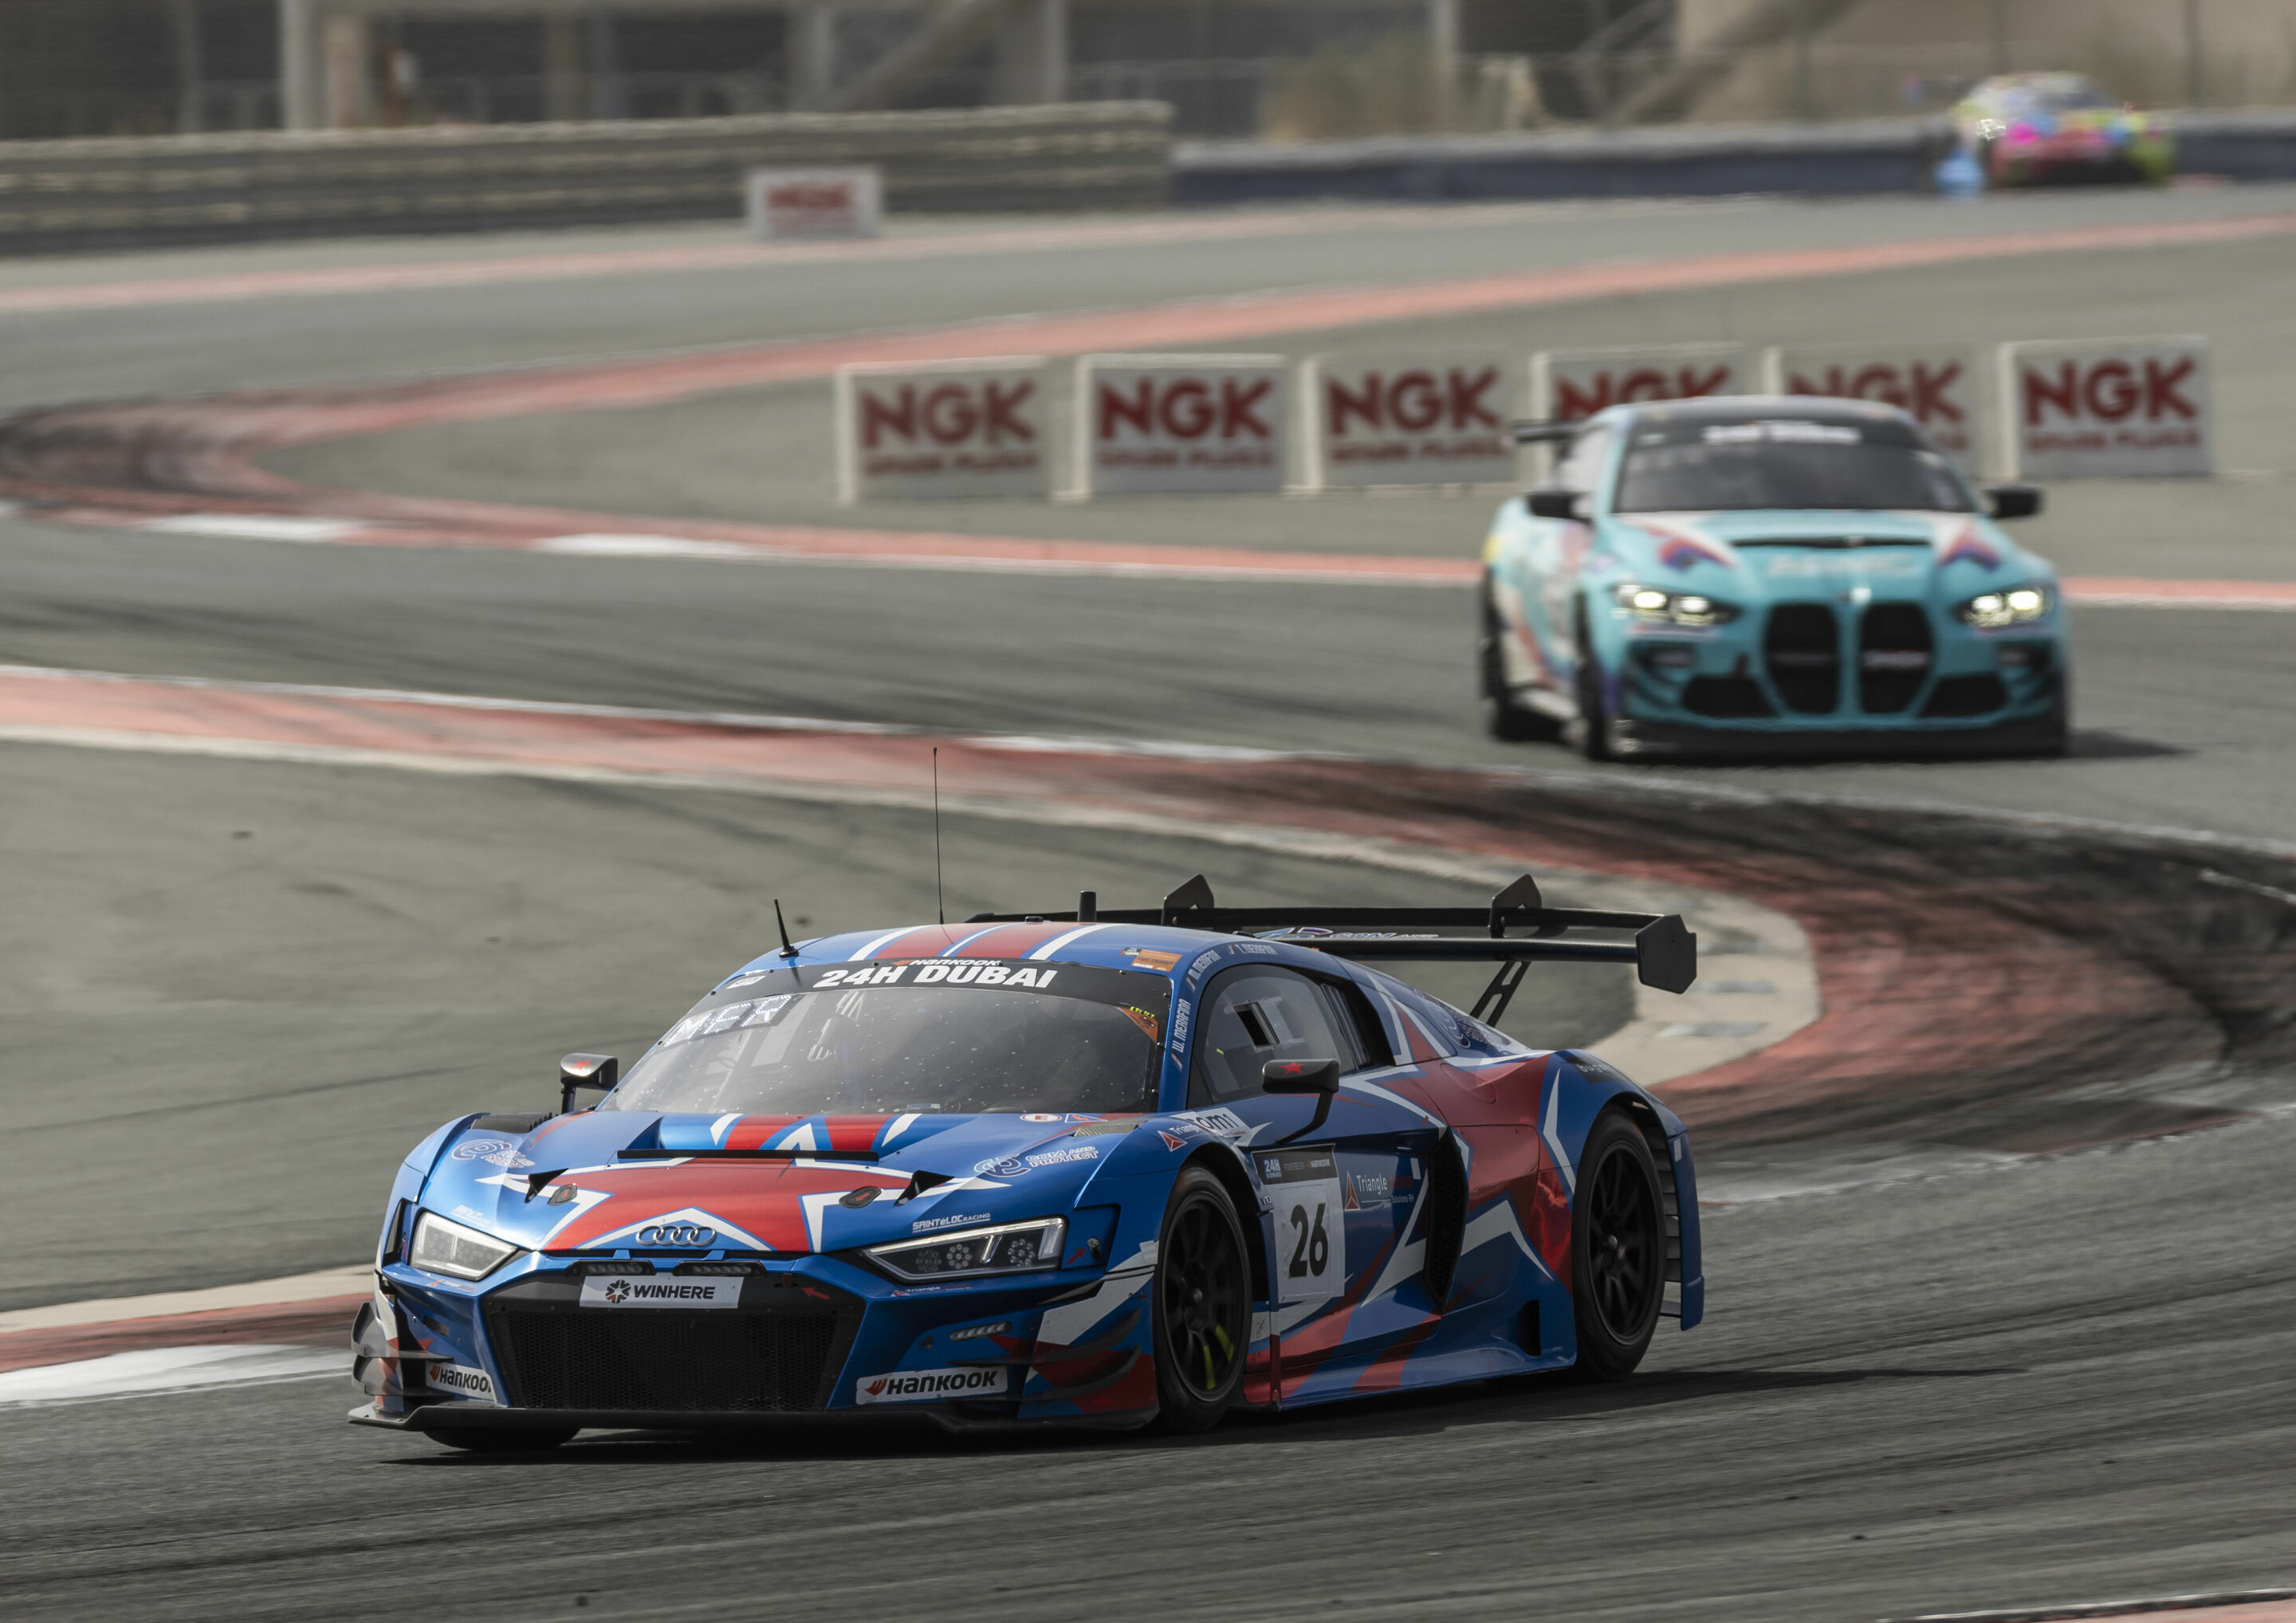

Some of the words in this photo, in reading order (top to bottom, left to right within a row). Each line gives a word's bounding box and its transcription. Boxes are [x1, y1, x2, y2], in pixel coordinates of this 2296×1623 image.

[1327, 364, 1500, 435] NGK
[2023, 356, 2197, 426] NGK
[859, 379, 1036, 448] NGK
[1097, 376, 1274, 441] NGK
[812, 966, 908, 988] 24H
[913, 965, 1058, 988] DUBAI
[1174, 998, 1191, 1042] MERAFINA
[1171, 1040, 1185, 1053] W.
[1025, 1150, 1066, 1161] COM
[1028, 1150, 1099, 1167] PROTECT
[1264, 1158, 1281, 1173] 24H
[1356, 1173, 1387, 1196] Triangle
[963, 1212, 991, 1222] RACING
[1288, 1202, 1329, 1279] 26
[634, 1285, 715, 1299] WINHERE
